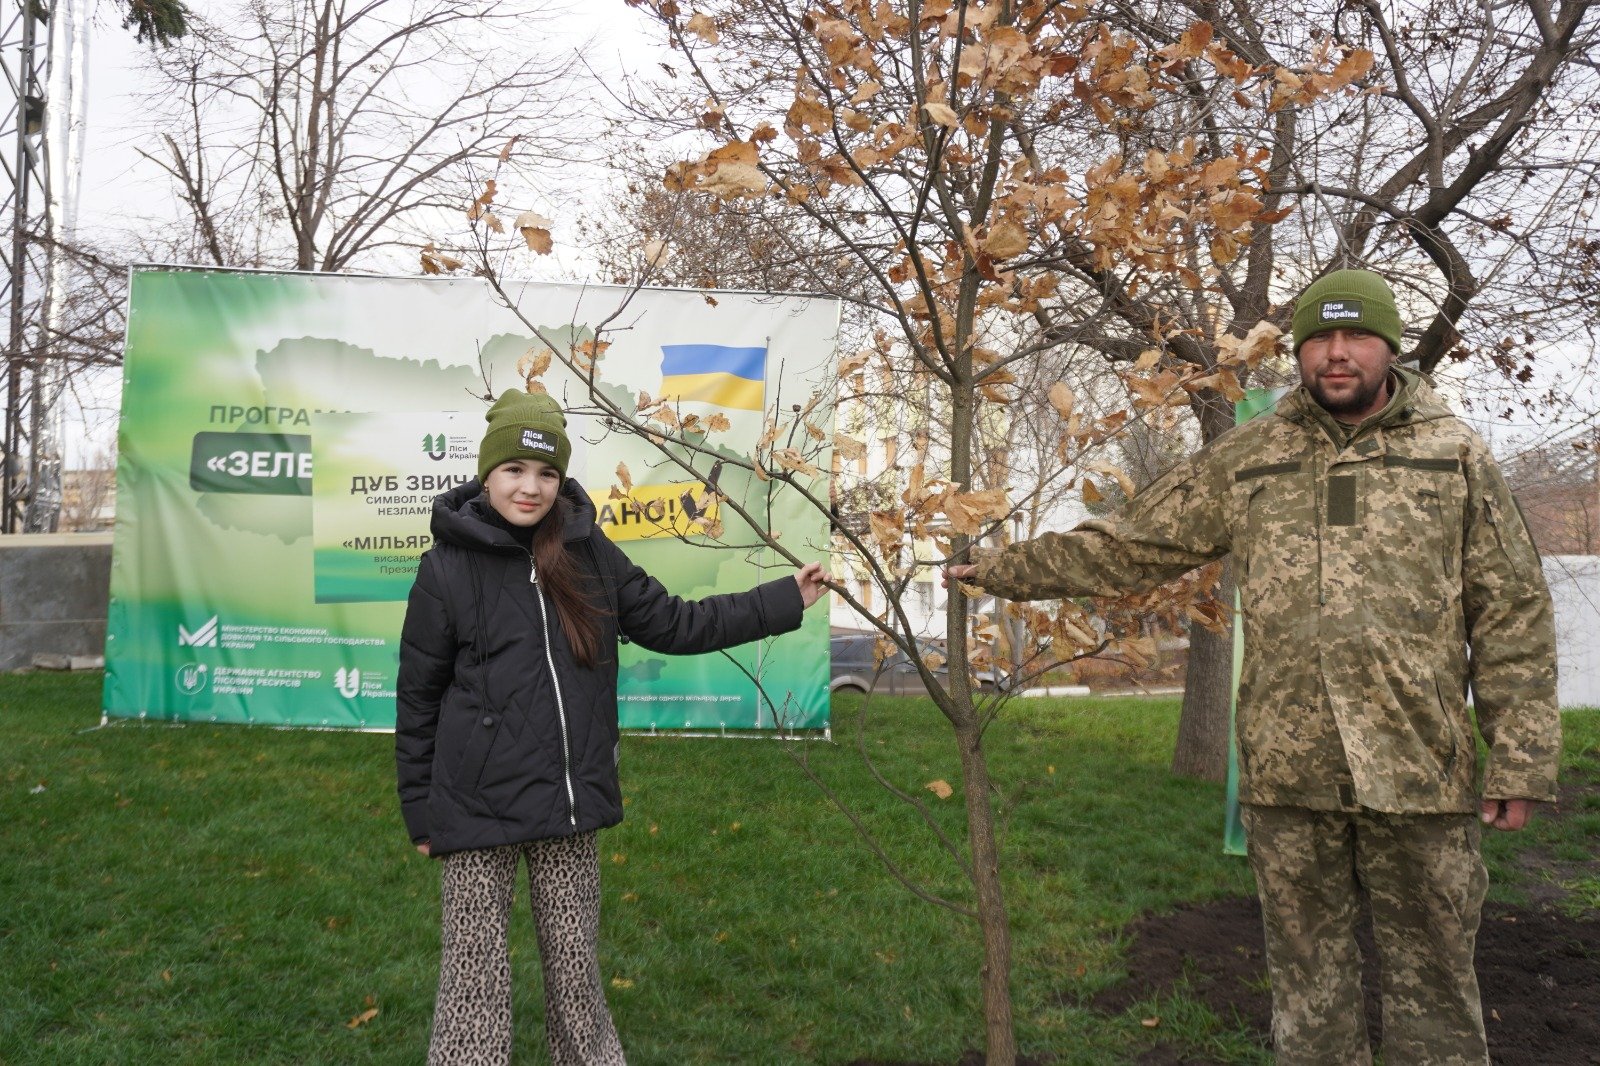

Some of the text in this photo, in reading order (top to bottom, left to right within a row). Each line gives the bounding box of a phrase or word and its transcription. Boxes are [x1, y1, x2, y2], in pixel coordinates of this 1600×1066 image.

[1323, 303, 1344, 311] Ліси
[209, 405, 352, 426] ПРОГРА
[523, 430, 543, 440] Ліси
[351, 474, 479, 495] ДУБ ЗВИЧ
[366, 495, 418, 505] СИМВОЛ
[342, 535, 433, 550] «МІЛЬЯР
[323, 637, 385, 646] ГОСПОДАРСТВА
[267, 669, 321, 679] АГЕНТСТВО
[256, 679, 301, 688] РЕСУРСІВ
